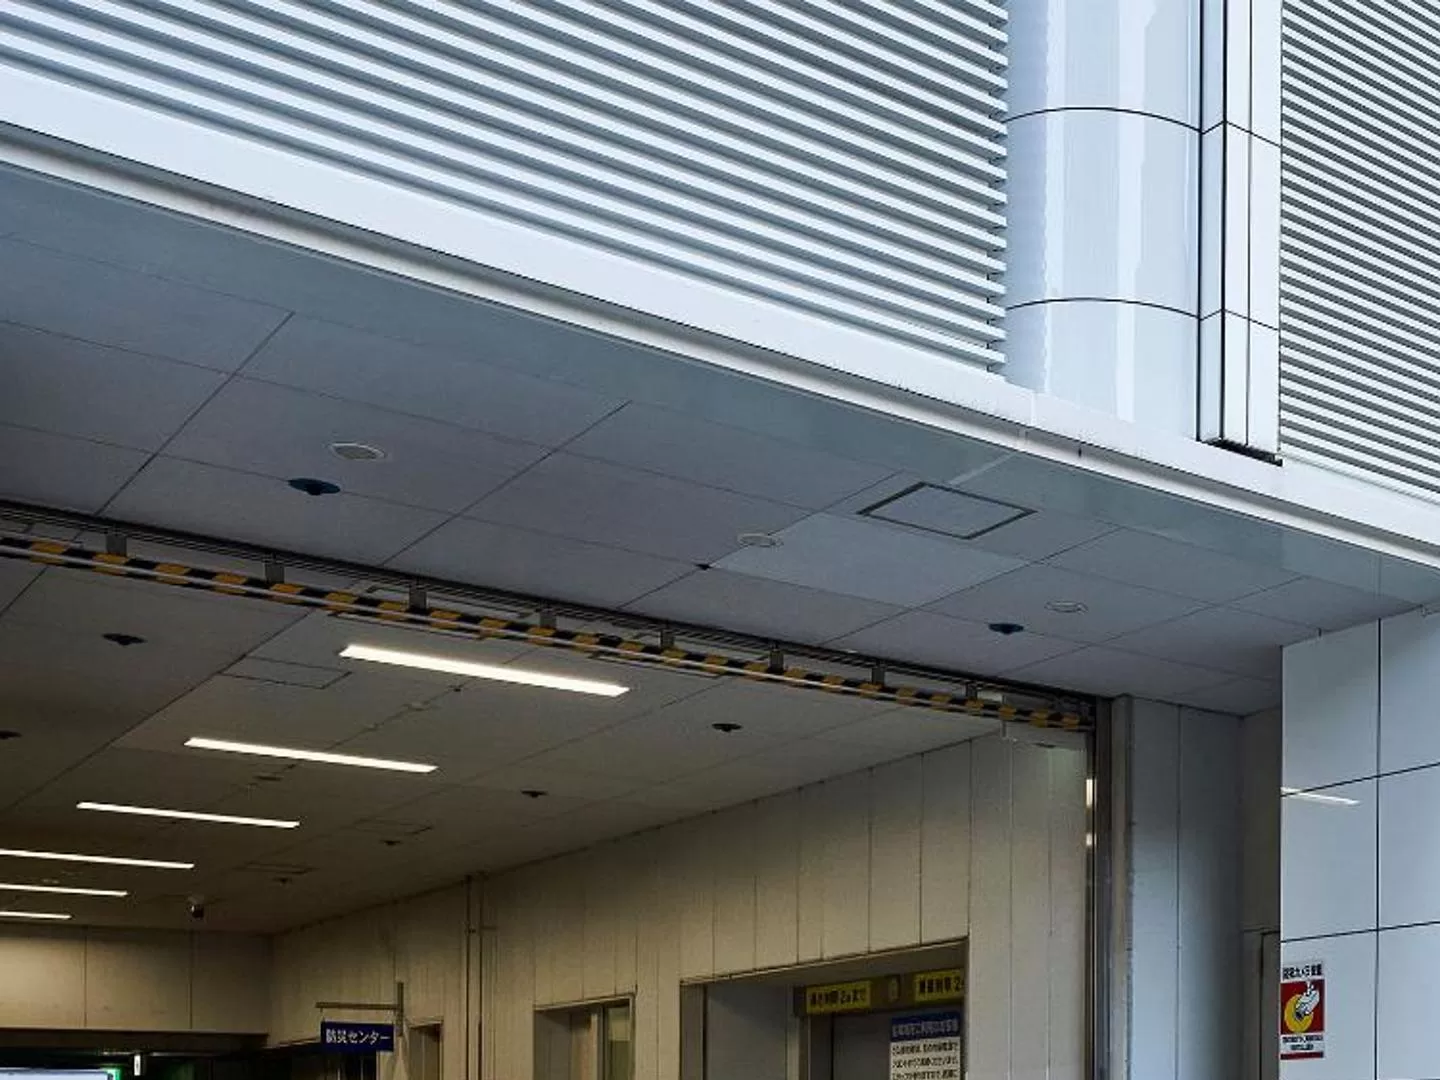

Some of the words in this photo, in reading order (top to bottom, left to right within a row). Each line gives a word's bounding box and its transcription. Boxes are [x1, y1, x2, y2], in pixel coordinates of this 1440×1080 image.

[325, 1028, 391, 1045] 防災センター
